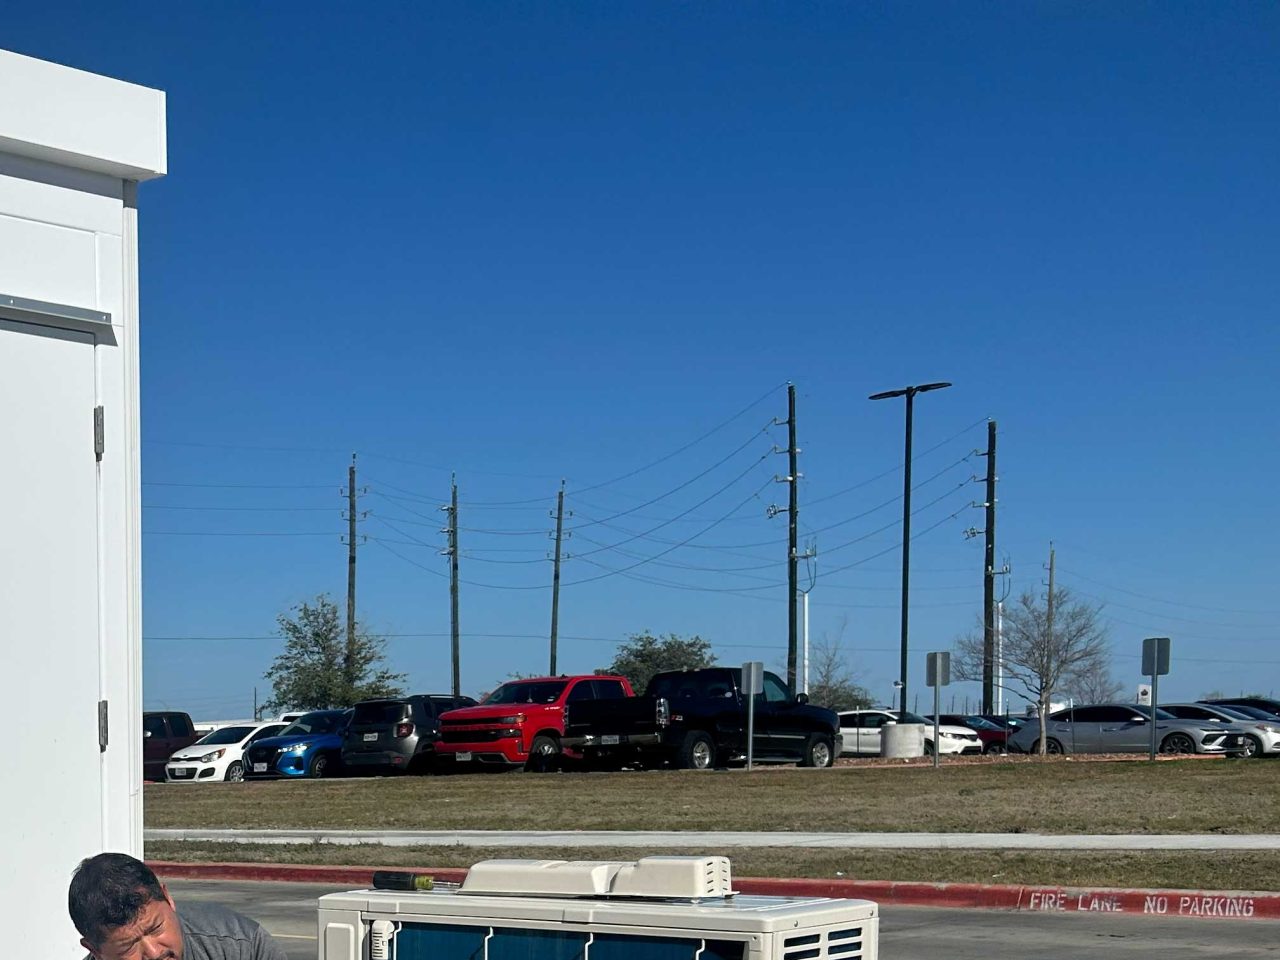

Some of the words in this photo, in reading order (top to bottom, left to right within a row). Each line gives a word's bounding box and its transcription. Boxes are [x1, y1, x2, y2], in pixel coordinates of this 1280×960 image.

[1029, 893, 1067, 911] FIRE
[1078, 894, 1123, 912] LANE
[1144, 896, 1168, 914] NO
[1179, 896, 1254, 917] PARKING
